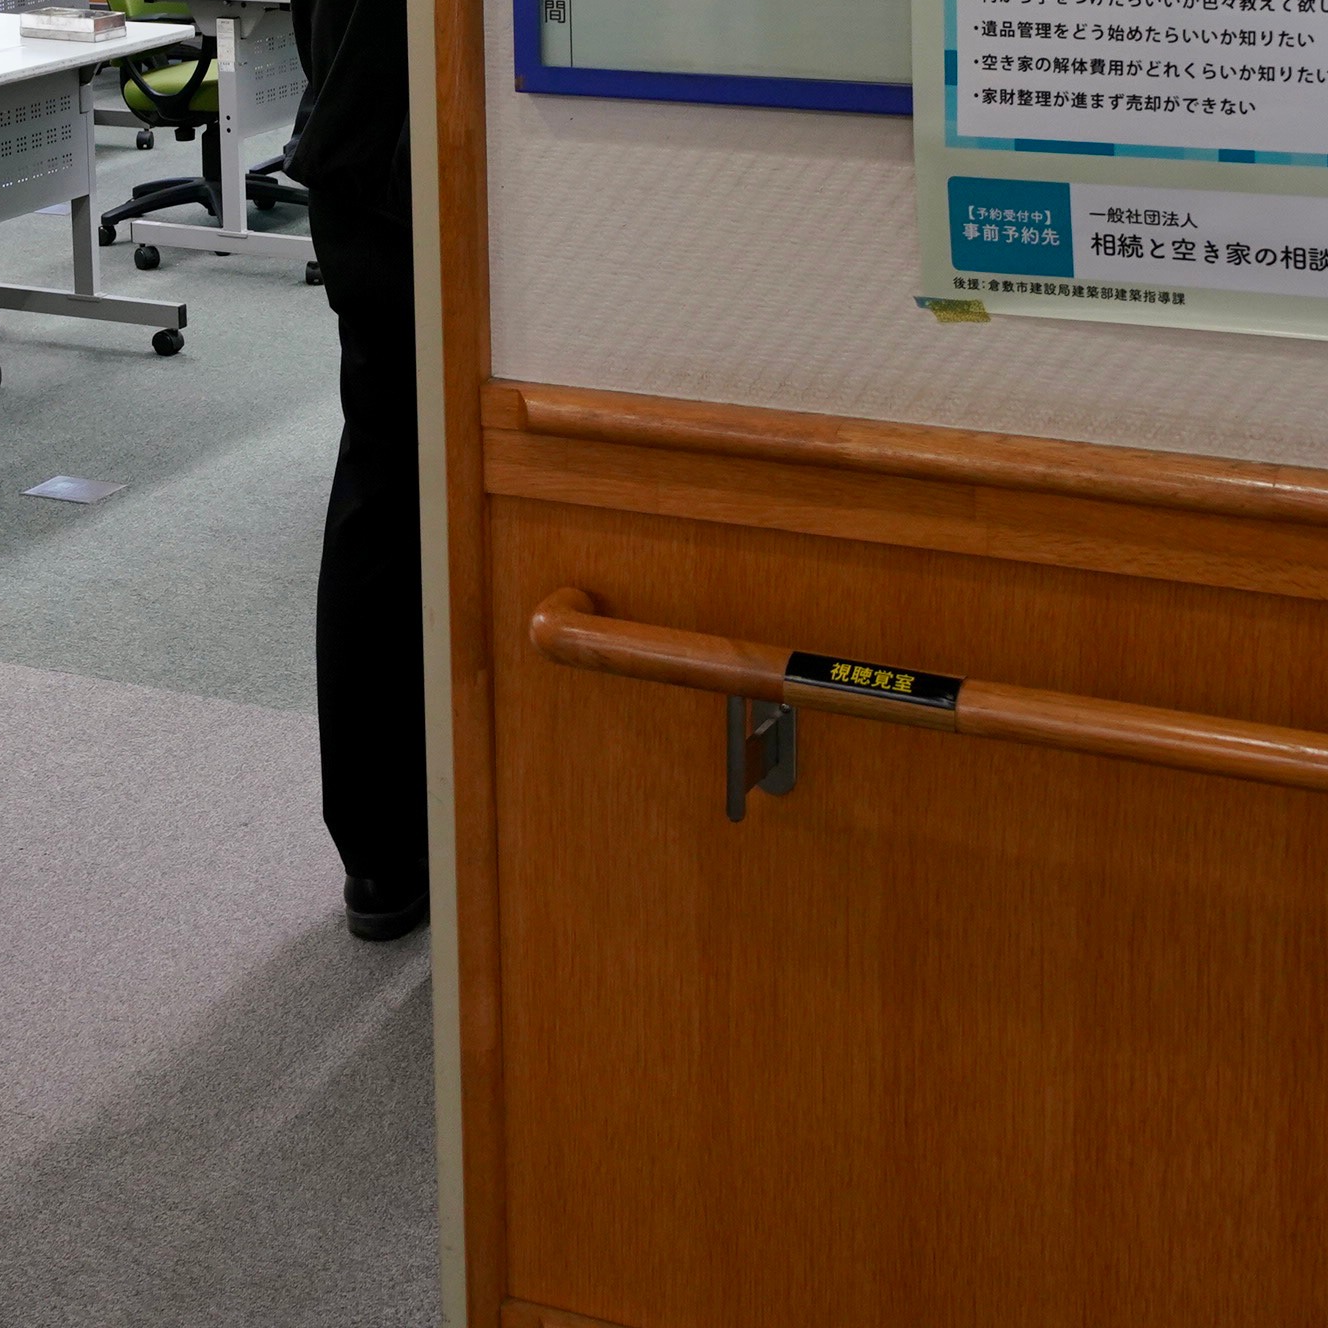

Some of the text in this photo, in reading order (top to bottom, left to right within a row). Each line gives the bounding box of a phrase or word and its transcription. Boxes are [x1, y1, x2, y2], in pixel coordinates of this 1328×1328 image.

[1088, 206, 1198, 229] 一般社団法人
[962, 223, 1060, 246] 事前予約先
[830, 662, 916, 694] 視聴覚室
